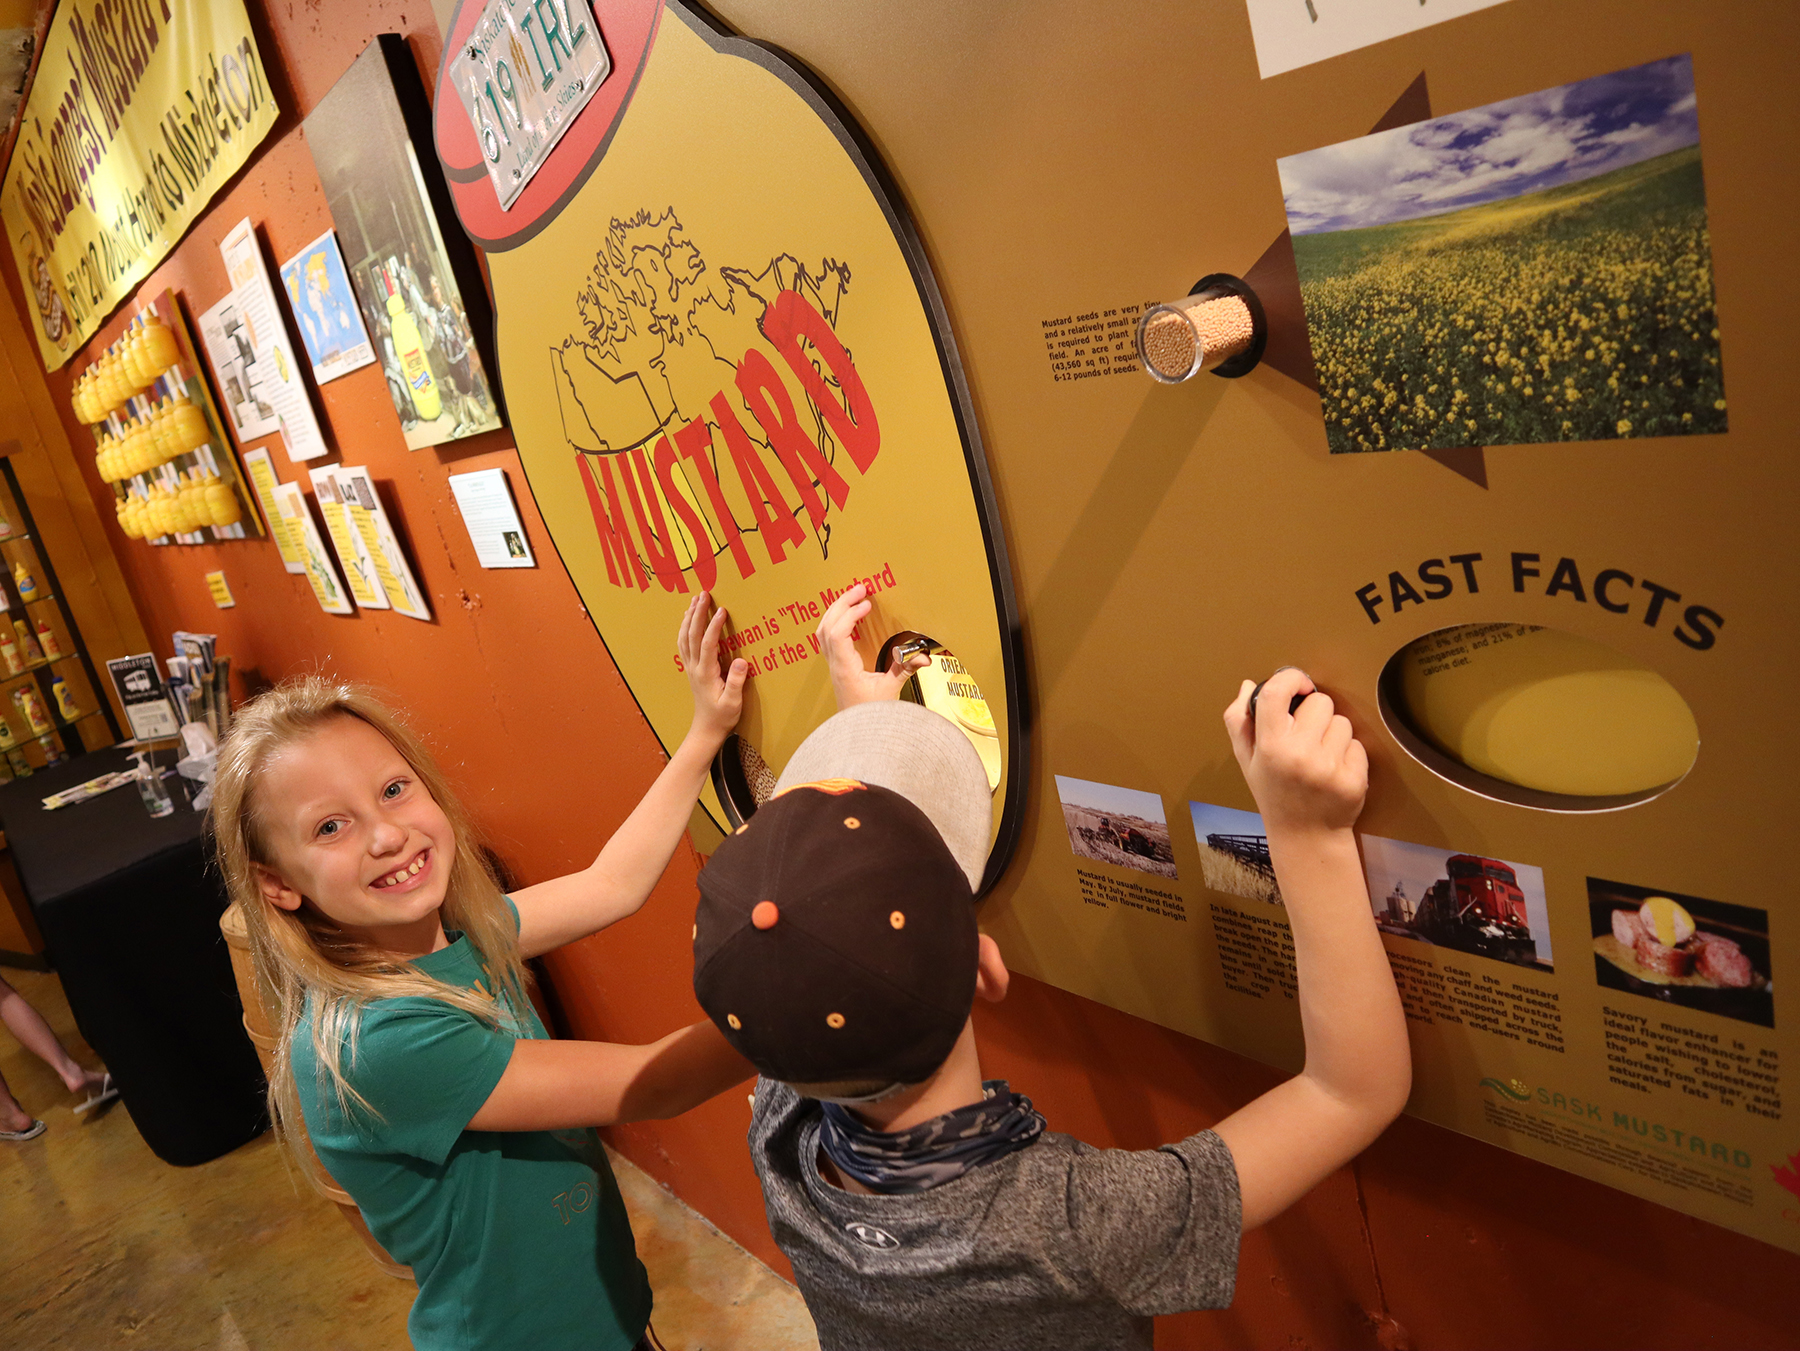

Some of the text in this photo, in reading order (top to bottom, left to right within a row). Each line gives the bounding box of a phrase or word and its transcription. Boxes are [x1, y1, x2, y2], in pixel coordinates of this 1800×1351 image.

[1042, 316, 1072, 328] Mustard
[1077, 312, 1099, 322] seeds
[1121, 306, 1139, 314] very
[1045, 330, 1058, 339] and
[1068, 322, 1104, 335] relatively
[1107, 318, 1129, 328] small
[1049, 351, 1068, 360] field.
[1092, 346, 1109, 354] acre
[1116, 342, 1123, 350] of
[1058, 336, 1090, 348] required
[1108, 330, 1129, 341] plant
[1052, 360, 1081, 372] (43,560
[1099, 356, 1109, 364] ft)
[1114, 350, 1138, 362] requir
[1054, 364, 1139, 381] 6-12 pounds of seeds.
[575, 289, 881, 594] MUSTARD
[1355, 551, 1725, 652] FAST FACTS
[762, 615, 780, 636] is
[1454, 633, 1462, 642] of
[763, 641, 808, 671] of the
[1417, 647, 1468, 666] manganese;
[1473, 638, 1488, 649] and
[1491, 632, 1513, 643] 21%
[1517, 626, 1525, 635] of
[941, 658, 969, 675] ORIEN
[1422, 657, 1471, 676] calorie diet.
[1077, 869, 1106, 882] Mustard
[1116, 881, 1142, 893] usually
[1145, 888, 1172, 900] seeded
[1175, 894, 1182, 902] in
[1079, 878, 1184, 912] May. By July, mustard fields
[1083, 897, 1109, 908] yellow.
[1097, 891, 1104, 899] in
[1106, 894, 1118, 902] full
[1120, 898, 1143, 909] flower
[1146, 906, 1160, 914] and
[1162, 909, 1187, 922] bright
[1274, 960, 1296, 971] on-fa
[1386, 950, 1432, 967] rocessors
[1603, 1007, 1777, 1059] Savory mustard is an
[1604, 1018, 1778, 1071] ideal flavor enhancer for
[1606, 1031, 1779, 1083] people wishing to lower
[1606, 1042, 1780, 1097] the salt, cholesterol,
[1608, 1054, 1780, 1108] calories from sugar, and
[1609, 1065, 1781, 1119] saturated fats in their
[1610, 1076, 1651, 1093] meals.
[1536, 1087, 1603, 1121] SASK
[1612, 1110, 1752, 1169] MUSTARD
[551, 1181, 596, 1225] TO
